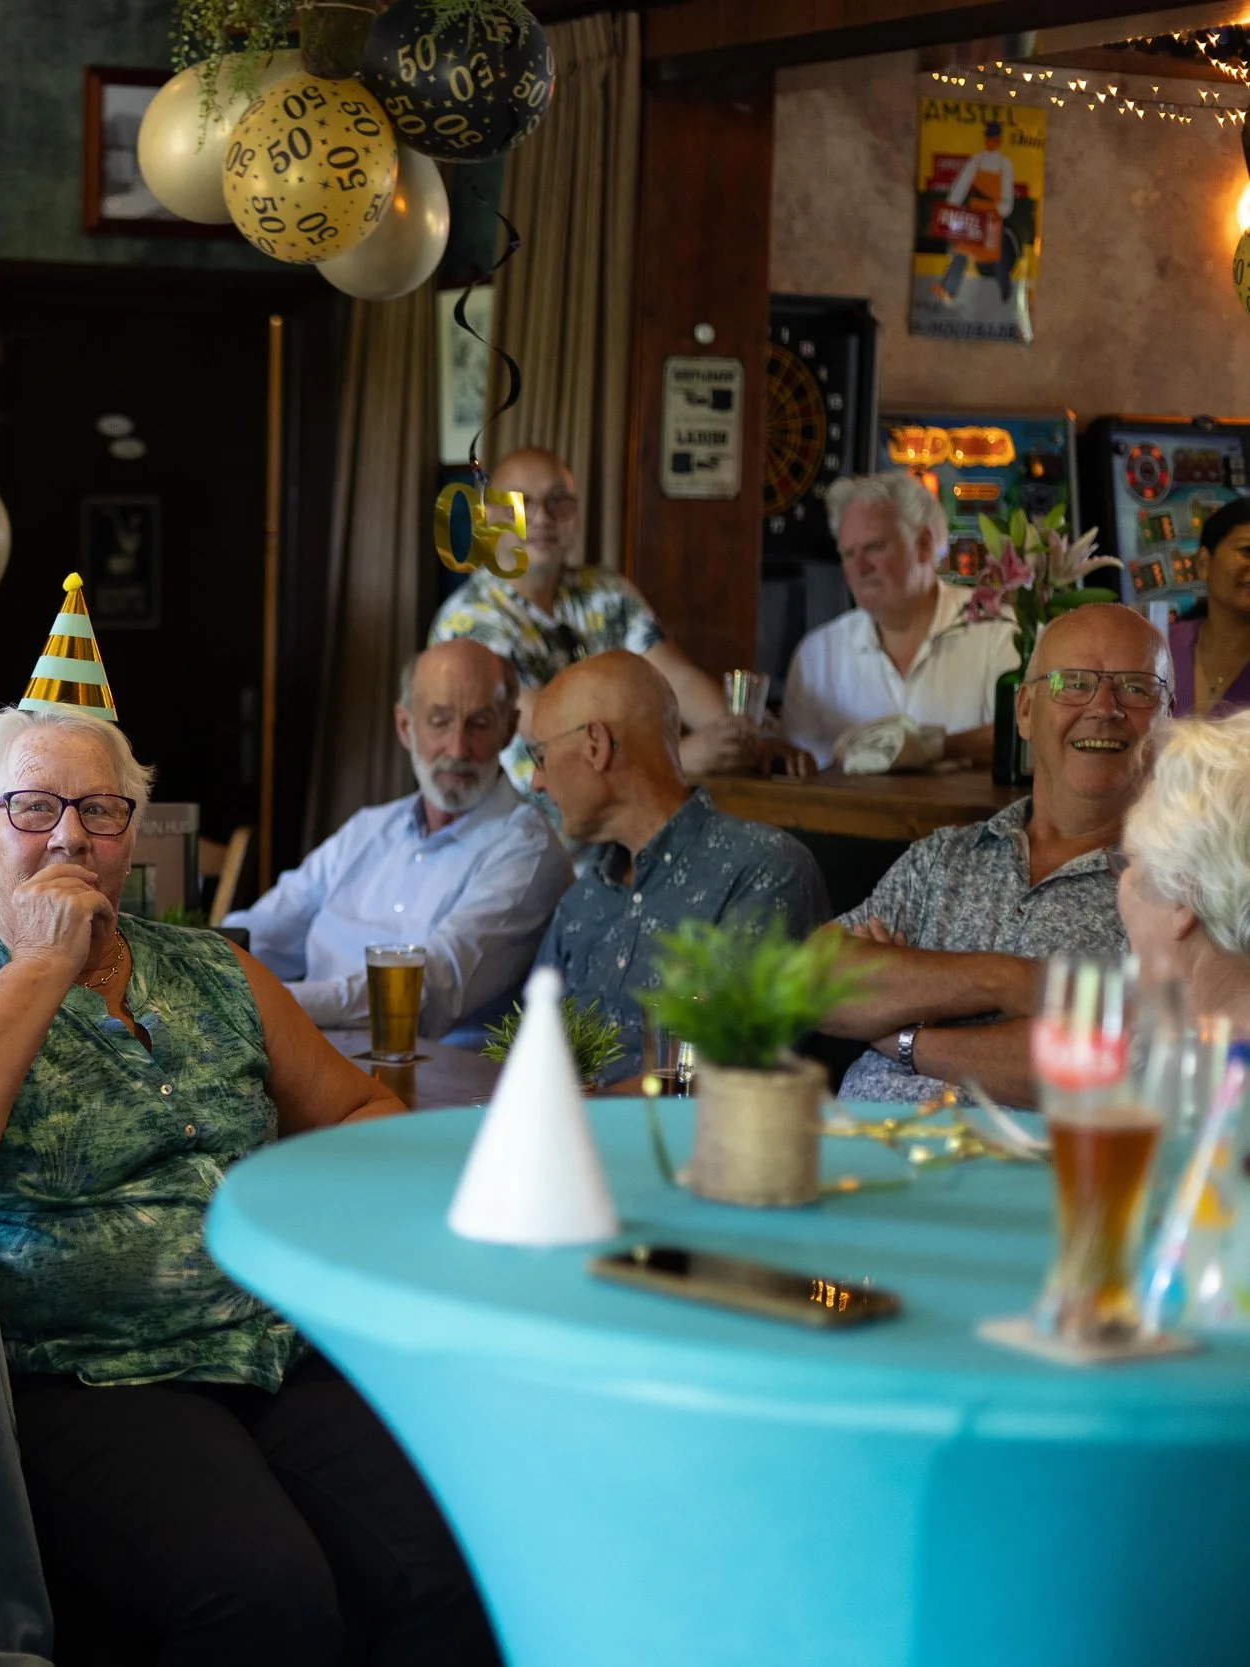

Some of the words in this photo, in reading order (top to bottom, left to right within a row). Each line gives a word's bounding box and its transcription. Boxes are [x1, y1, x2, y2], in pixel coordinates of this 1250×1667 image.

[397, 33, 438, 84] 50
[449, 51, 495, 102] 50
[283, 85, 328, 120] 50
[512, 70, 547, 108] 50
[340, 101, 381, 137] 50
[385, 95, 427, 135] 50
[432, 113, 484, 150] 50
[924, 99, 1017, 127] AMSTEL
[224, 141, 256, 178] 50
[266, 126, 313, 174] 50
[326, 146, 368, 191] 50
[251, 196, 287, 234] 50
[296, 211, 339, 246] 50
